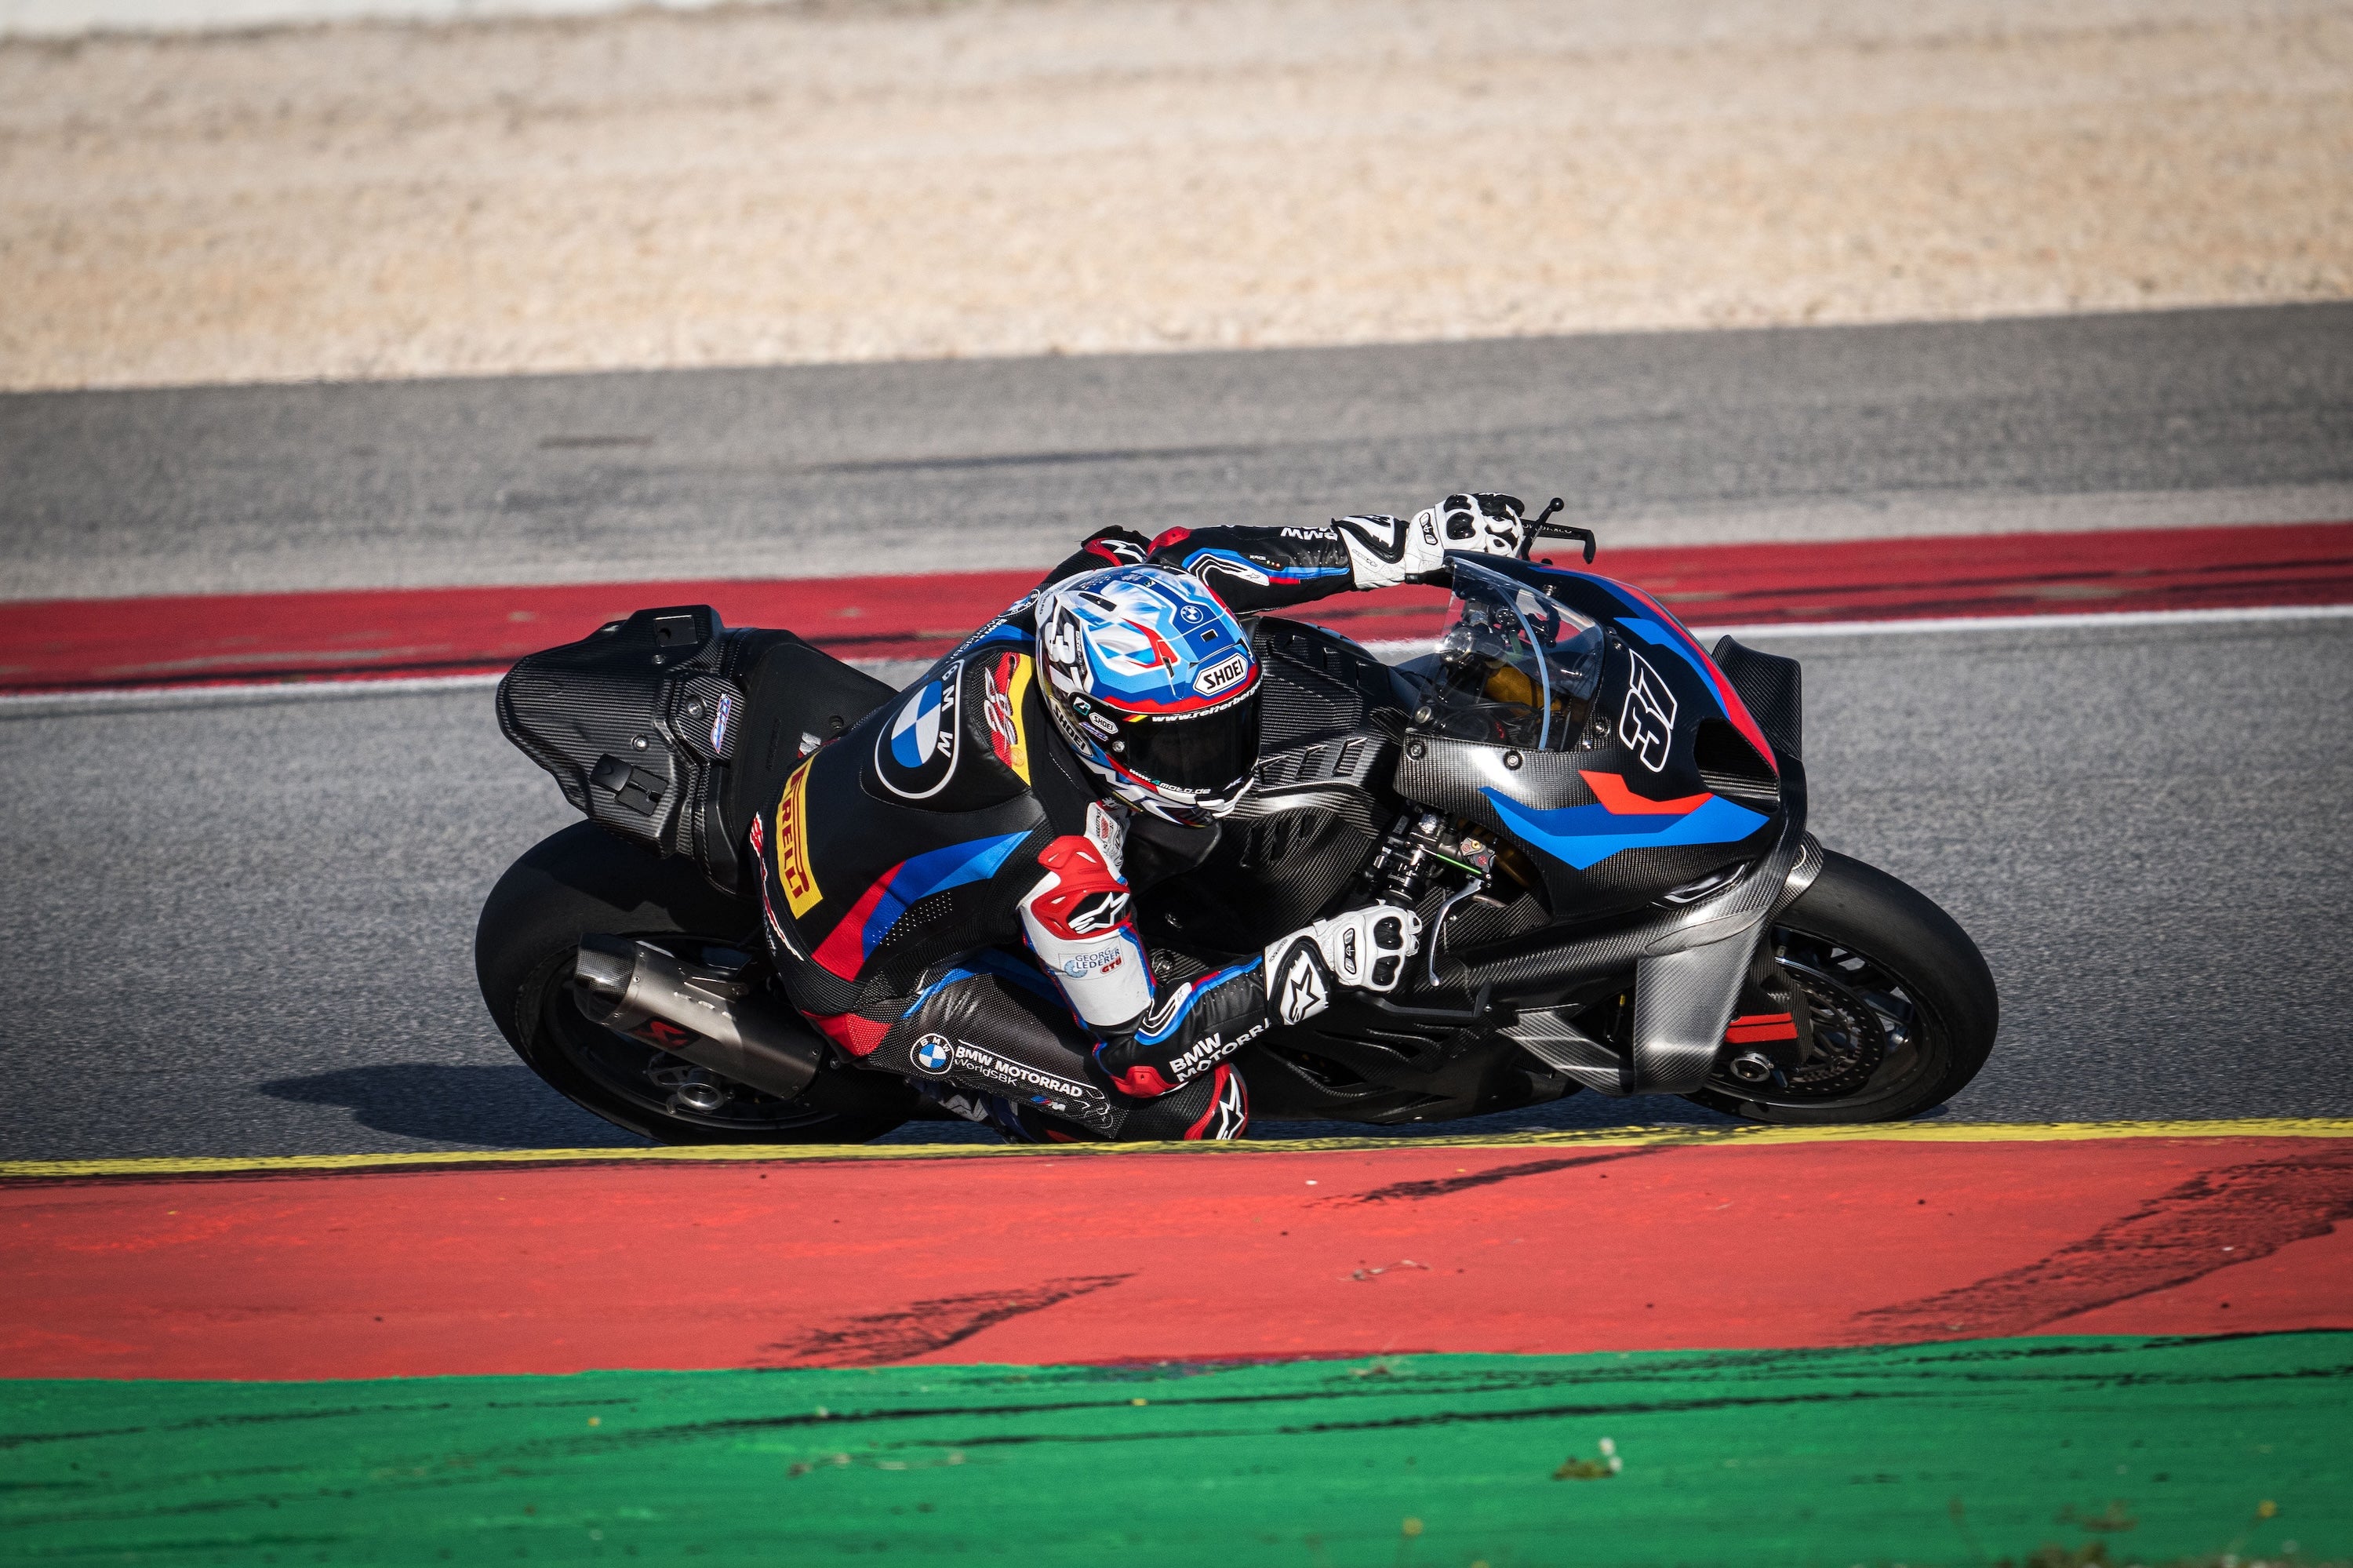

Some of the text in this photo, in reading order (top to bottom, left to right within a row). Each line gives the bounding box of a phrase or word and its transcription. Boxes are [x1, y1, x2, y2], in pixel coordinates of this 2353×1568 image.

[1203, 659, 1244, 690] SHOEI
[1094, 715, 1113, 730] SHOEI
[1619, 648, 1678, 773] 37
[1053, 704, 1086, 751] SHOEI
[1129, 768, 1212, 795] www.4moto.de
[782, 764, 809, 899] PRELLI
[1075, 947, 1111, 962] GEORG
[1076, 948, 1120, 970] LEDERER
[920, 1035, 951, 1053] BMW
[1169, 1032, 1221, 1073] BMW
[954, 1058, 1018, 1087] WorldSBK
[955, 1046, 1083, 1097] BMW MOTORRAD
